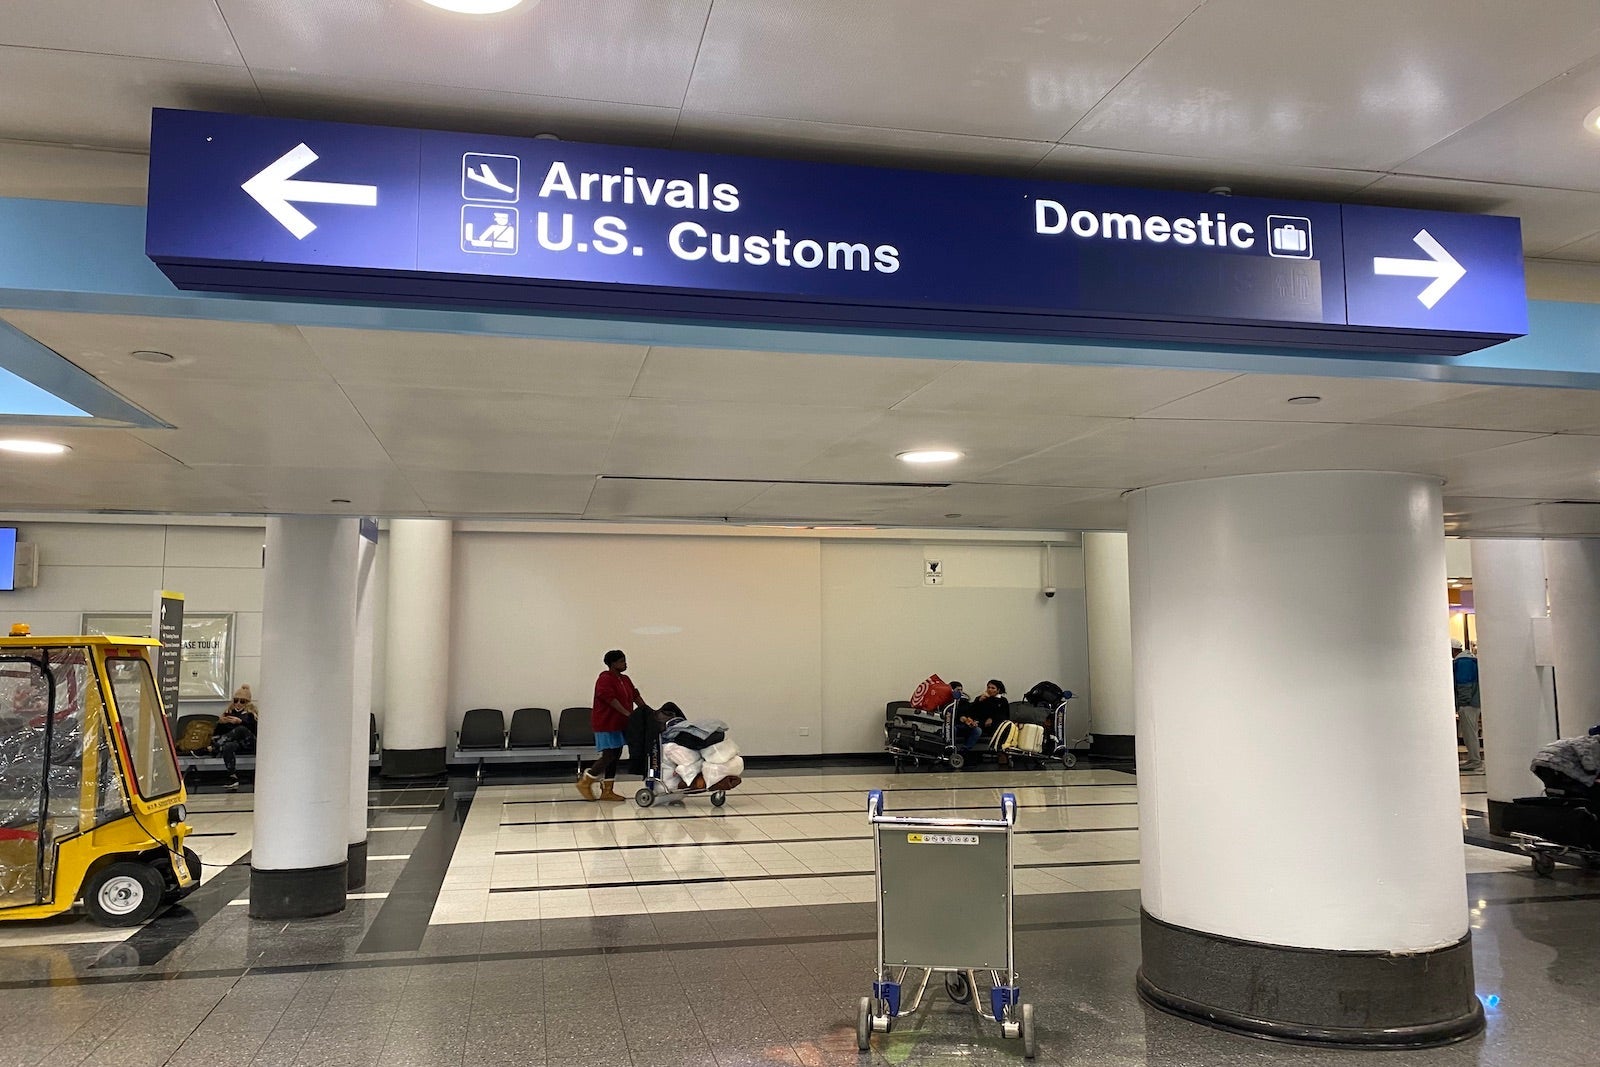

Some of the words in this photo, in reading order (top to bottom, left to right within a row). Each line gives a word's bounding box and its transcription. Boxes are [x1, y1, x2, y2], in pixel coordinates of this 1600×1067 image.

[538, 161, 740, 212] Arrivals
[537, 212, 643, 257] U.S.
[668, 221, 900, 274] Customs
[1035, 199, 1255, 249] Domestic
